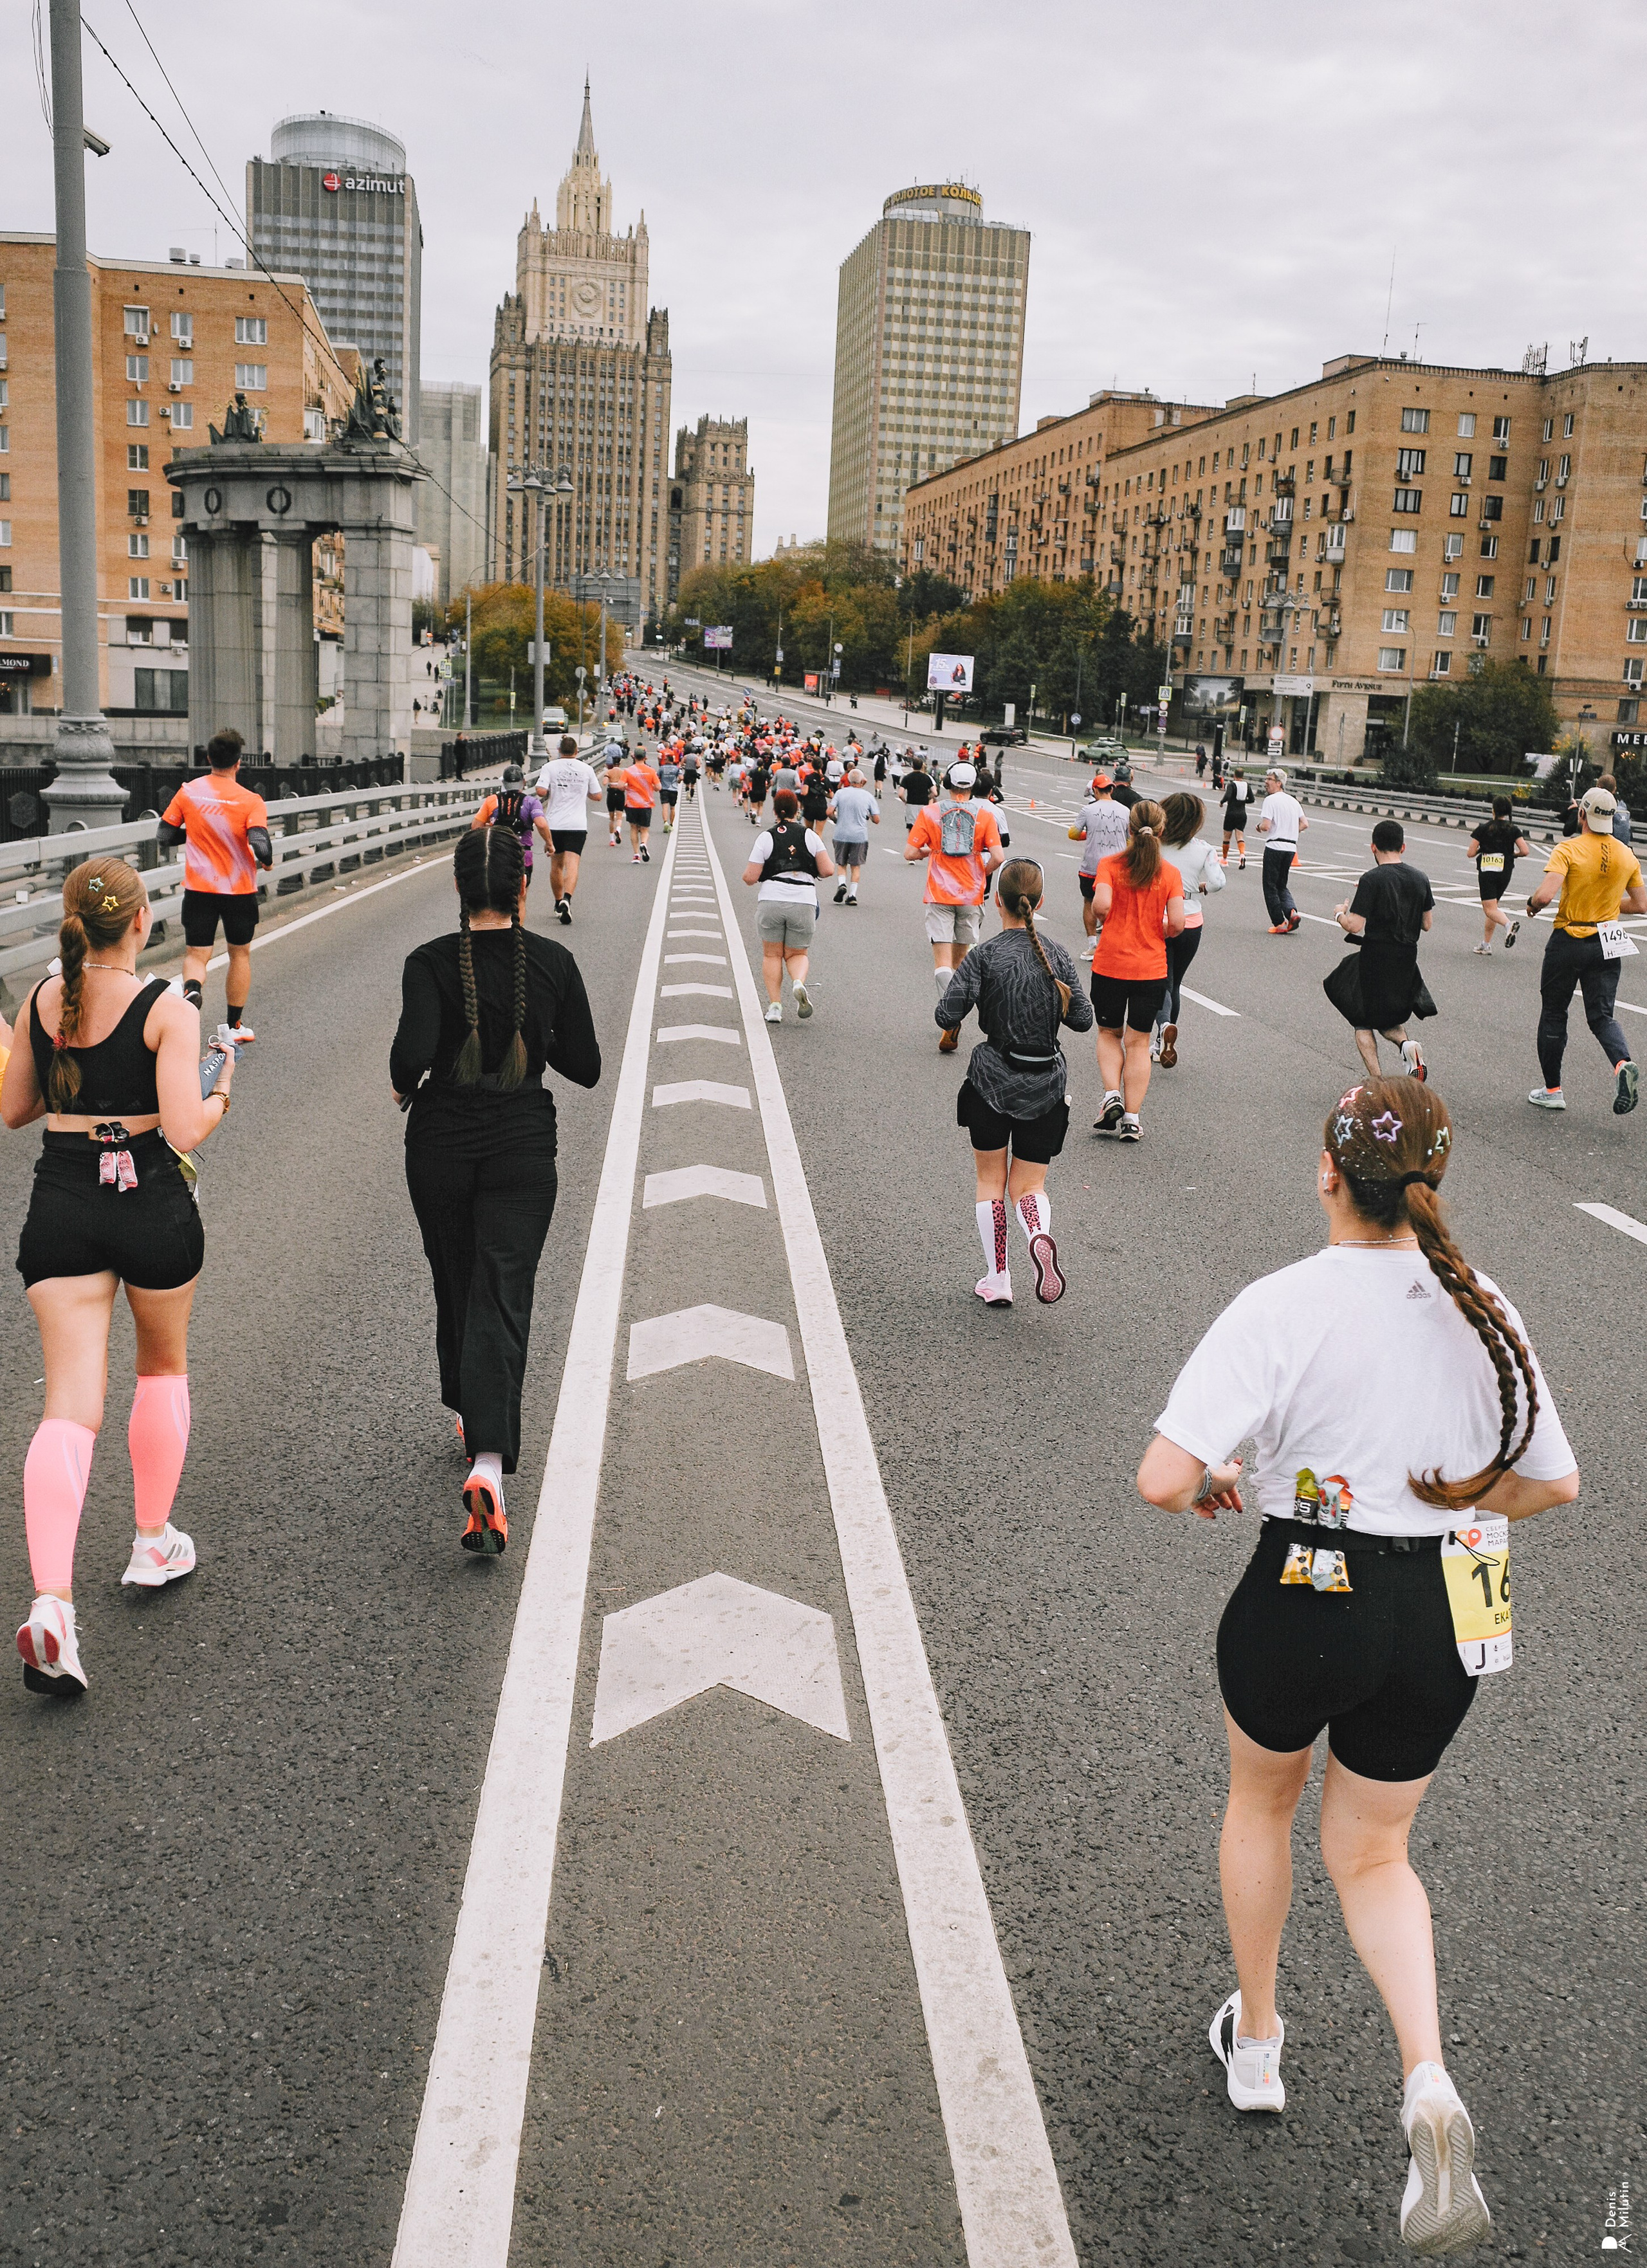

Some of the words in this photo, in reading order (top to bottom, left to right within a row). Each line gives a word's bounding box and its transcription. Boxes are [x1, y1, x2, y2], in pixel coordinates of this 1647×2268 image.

[345, 175, 405, 193] azimut
[941, 185, 982, 205] КОЛЬЦО
[1332, 680, 1353, 688] FIFTH
[1354, 681, 1383, 690] AVENUE
[203, 1052, 226, 1077] NASPO
[1475, 1643, 1486, 1670] J
